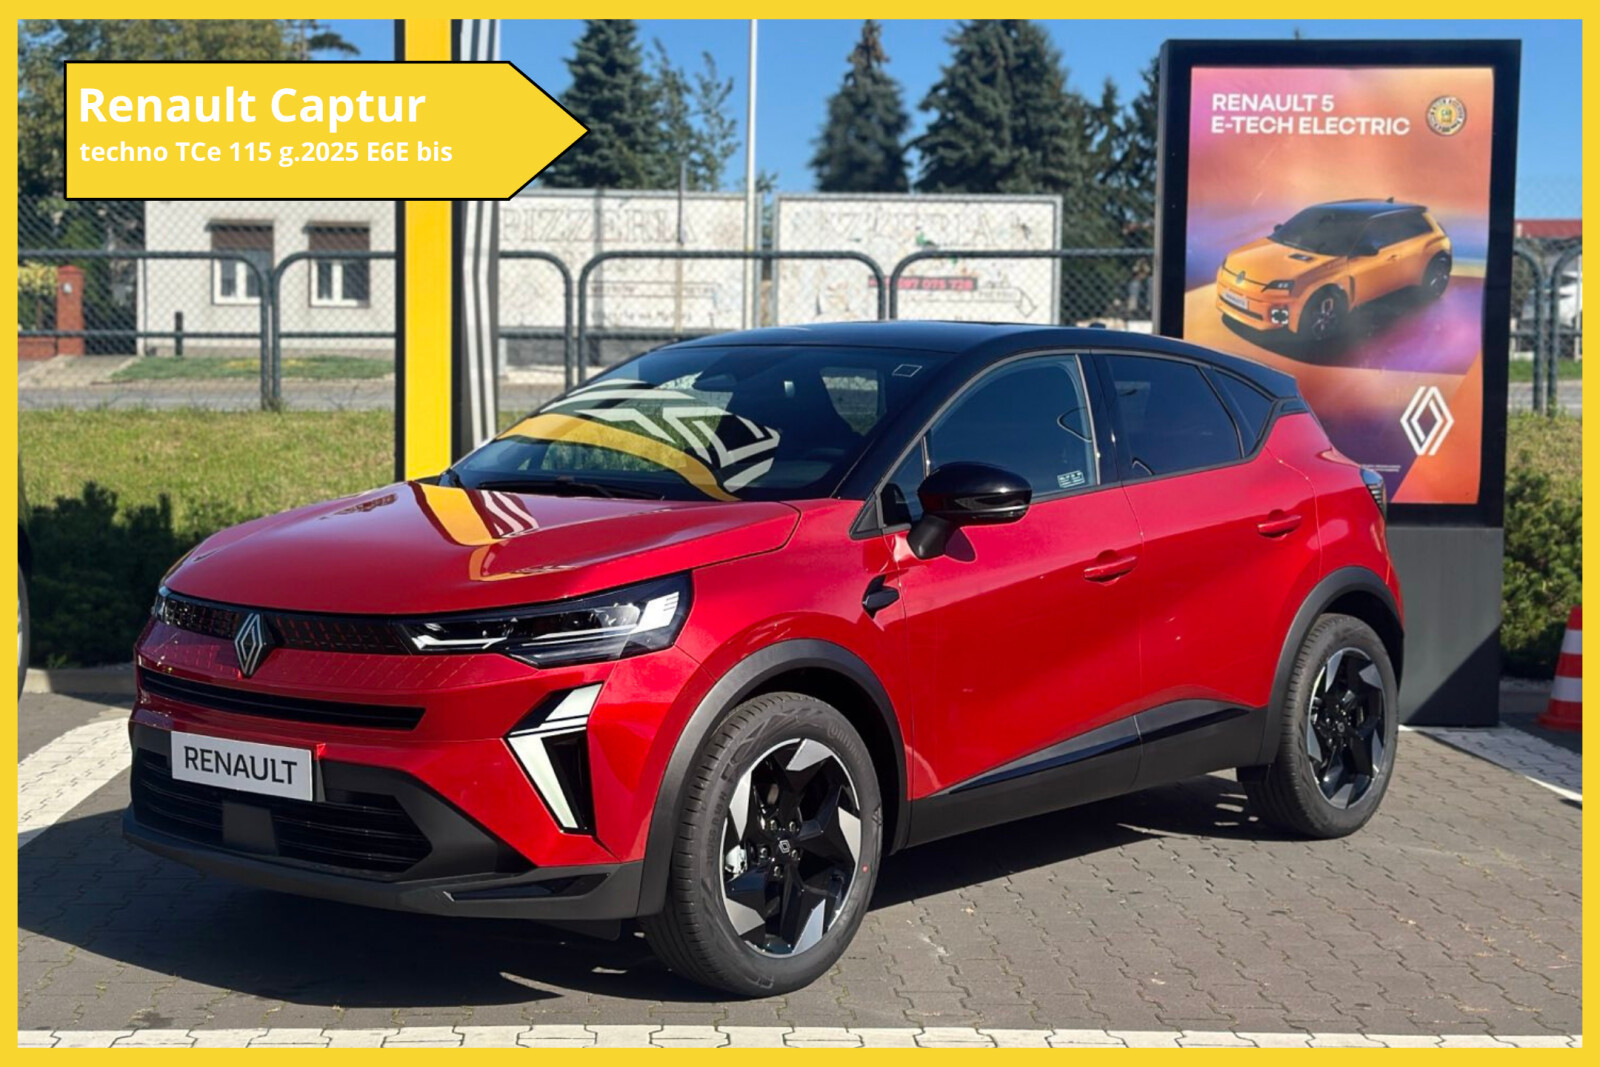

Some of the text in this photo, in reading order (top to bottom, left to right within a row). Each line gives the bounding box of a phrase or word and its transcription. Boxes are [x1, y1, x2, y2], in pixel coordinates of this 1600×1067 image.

[1212, 93, 1334, 112] RENAULT 5
[1211, 115, 1410, 135] E-TECH ELECTRIC
[184, 745, 298, 785] RENAULT
